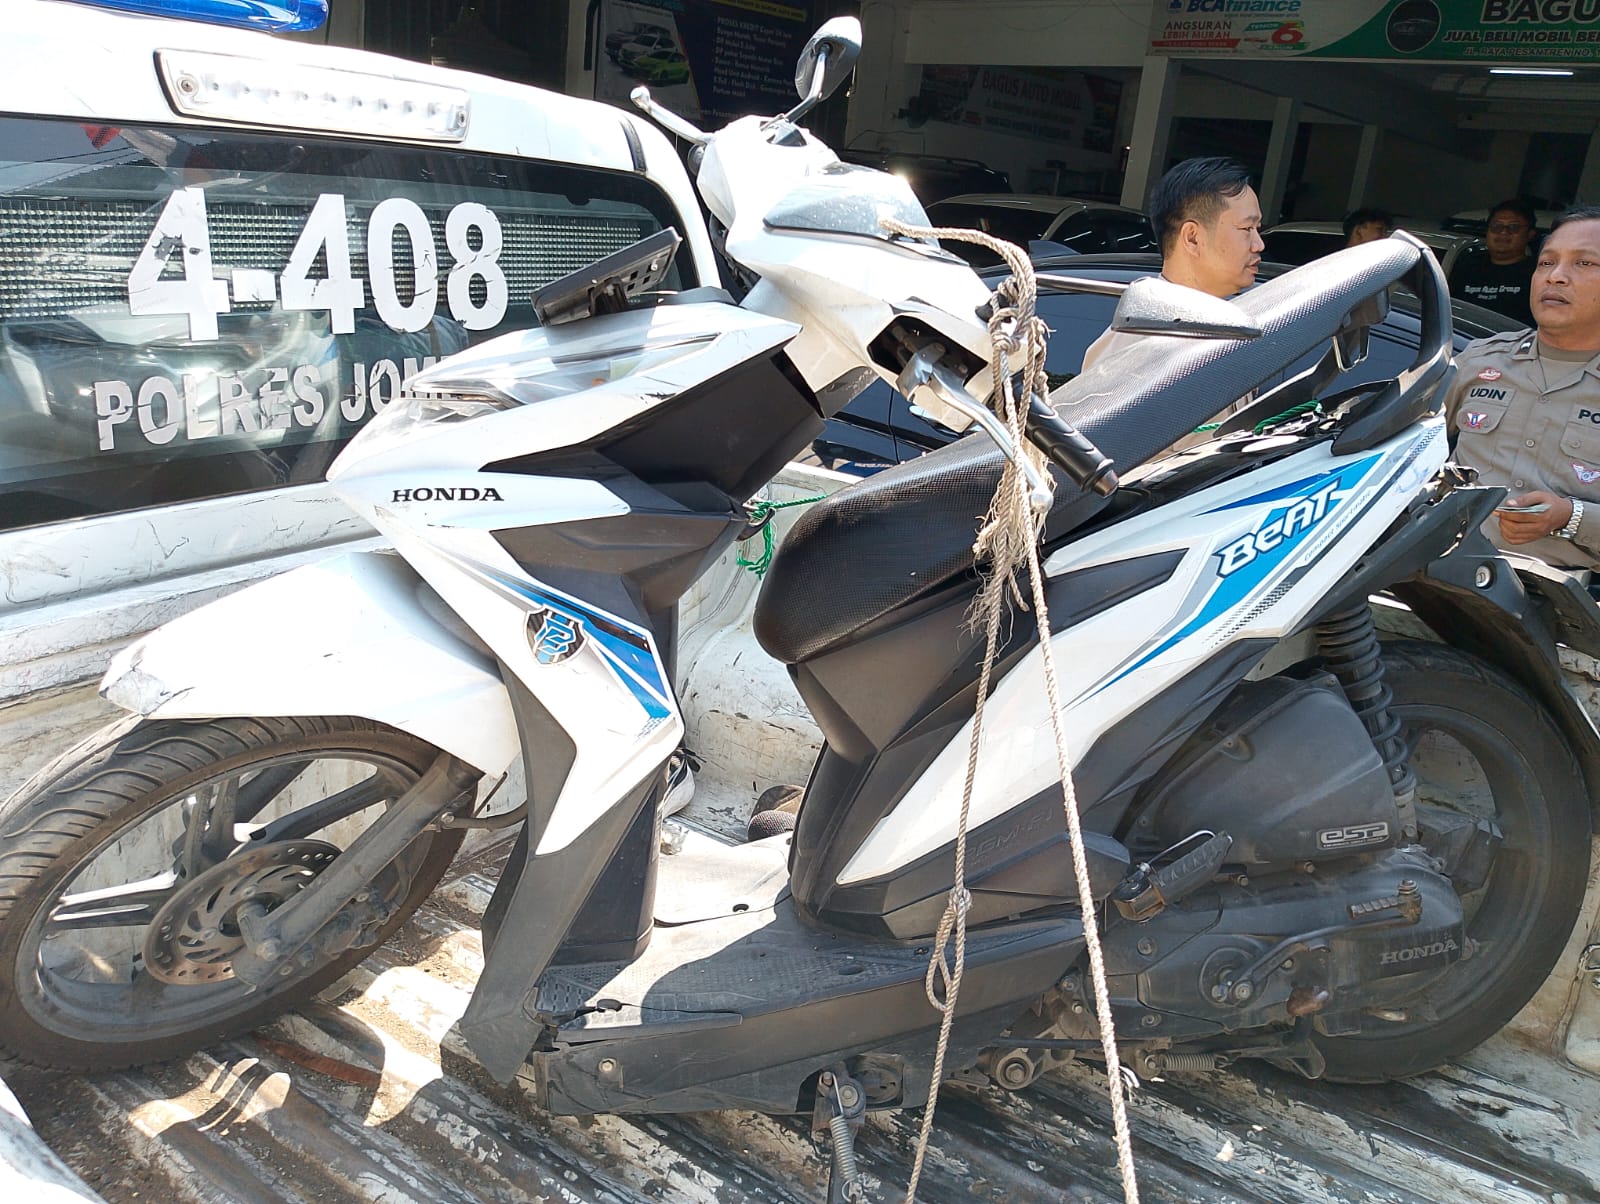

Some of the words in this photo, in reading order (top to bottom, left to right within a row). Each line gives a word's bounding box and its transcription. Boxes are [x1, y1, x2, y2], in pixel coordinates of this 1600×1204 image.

[1165, 21, 1232, 30] ANGSURAN
[1163, 31, 1189, 39] LEBIH
[1192, 31, 1230, 39] MURAH
[1443, 30, 1480, 43] JUAL
[1484, 30, 1516, 43] BELI
[1519, 30, 1572, 43] MOBIL
[1508, 47, 1572, 56] PESANTREN
[128, 187, 509, 341] 4-408
[1470, 388, 1506, 401] UDIN
[94, 364, 324, 450] POLRES
[391, 487, 504, 502] HONDA
[1379, 938, 1458, 965] HONDA
